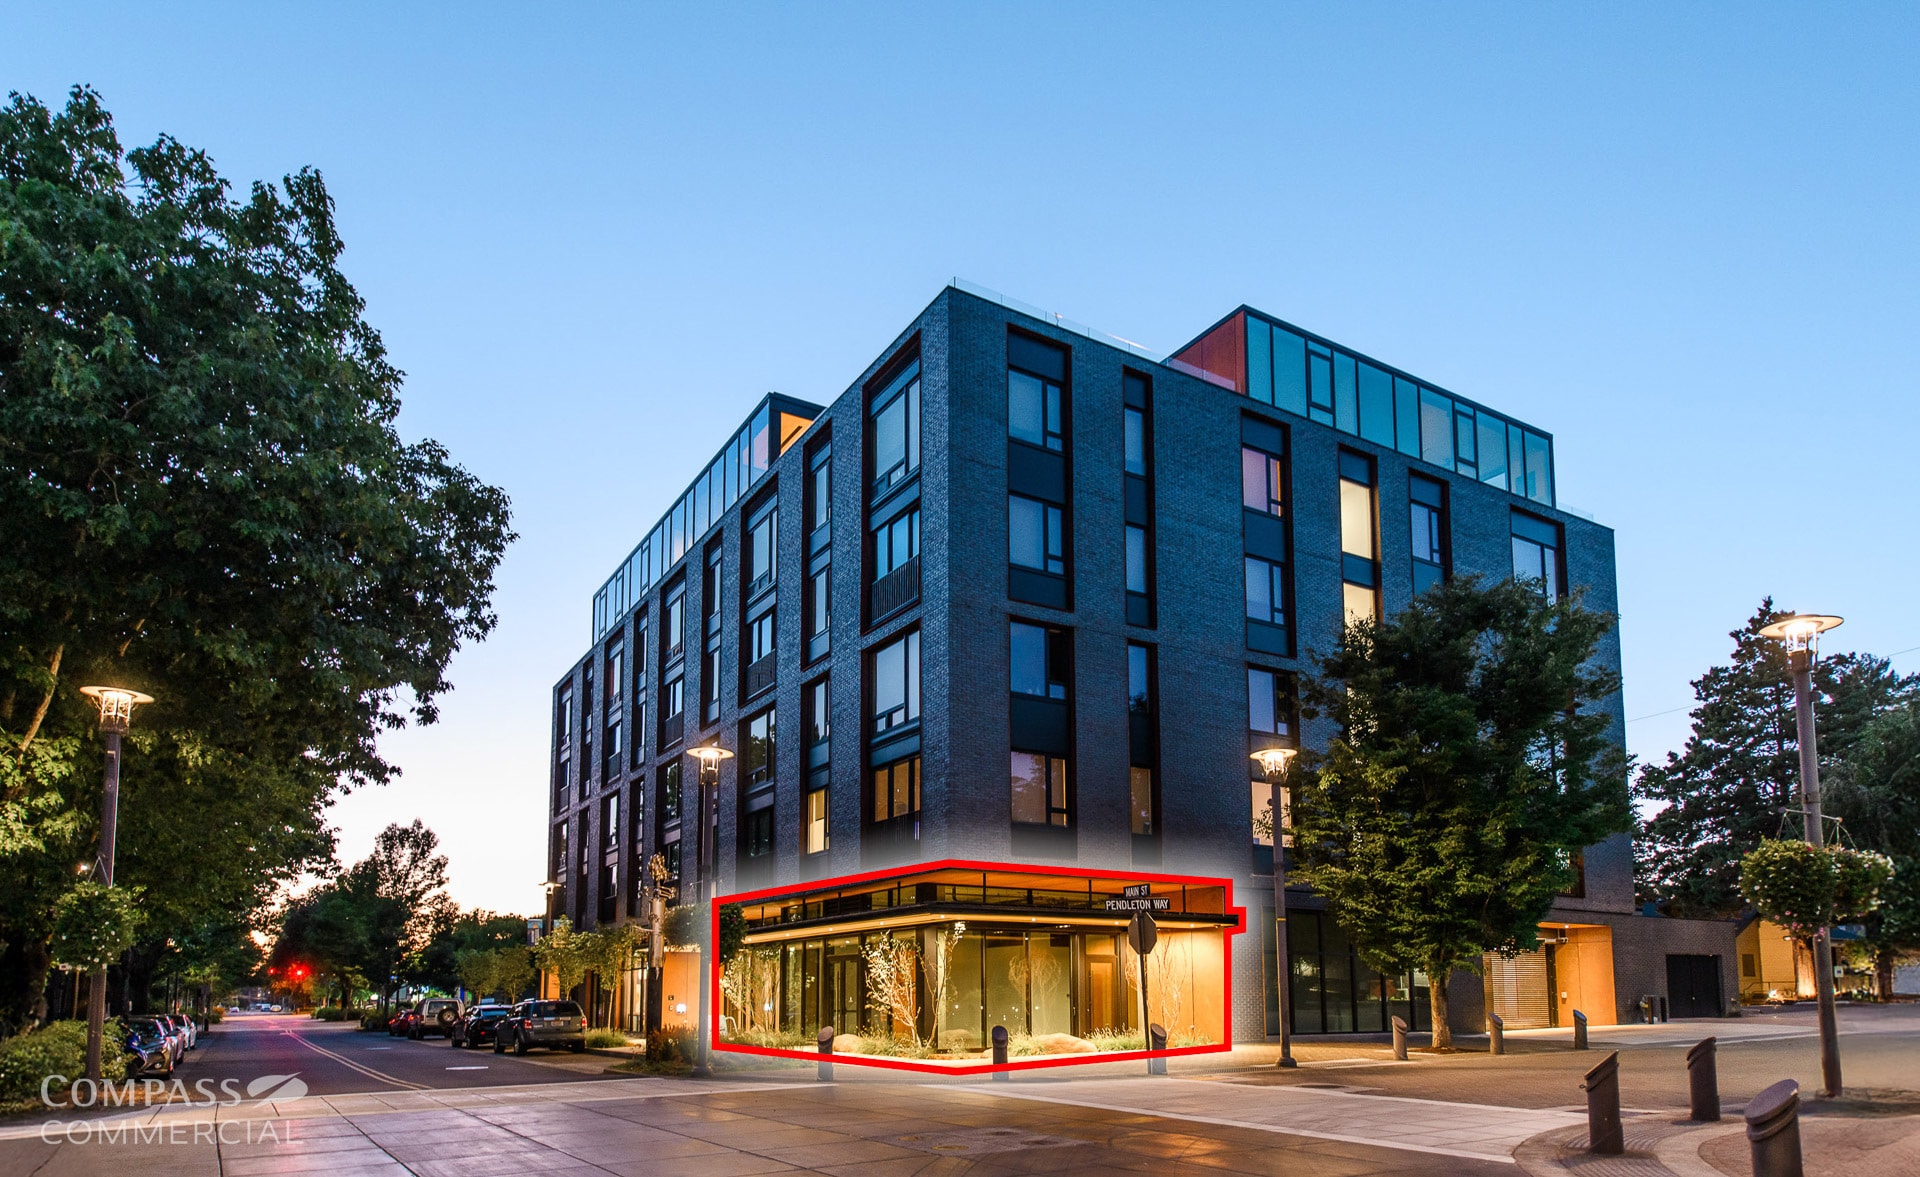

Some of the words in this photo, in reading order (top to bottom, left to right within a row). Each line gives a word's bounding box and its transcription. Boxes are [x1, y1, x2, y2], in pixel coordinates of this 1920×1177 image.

[1125, 886, 1139, 897] MAIN
[1140, 885, 1148, 895] ST
[1106, 900, 1150, 910] PENDLETON
[1153, 899, 1169, 909] WAY
